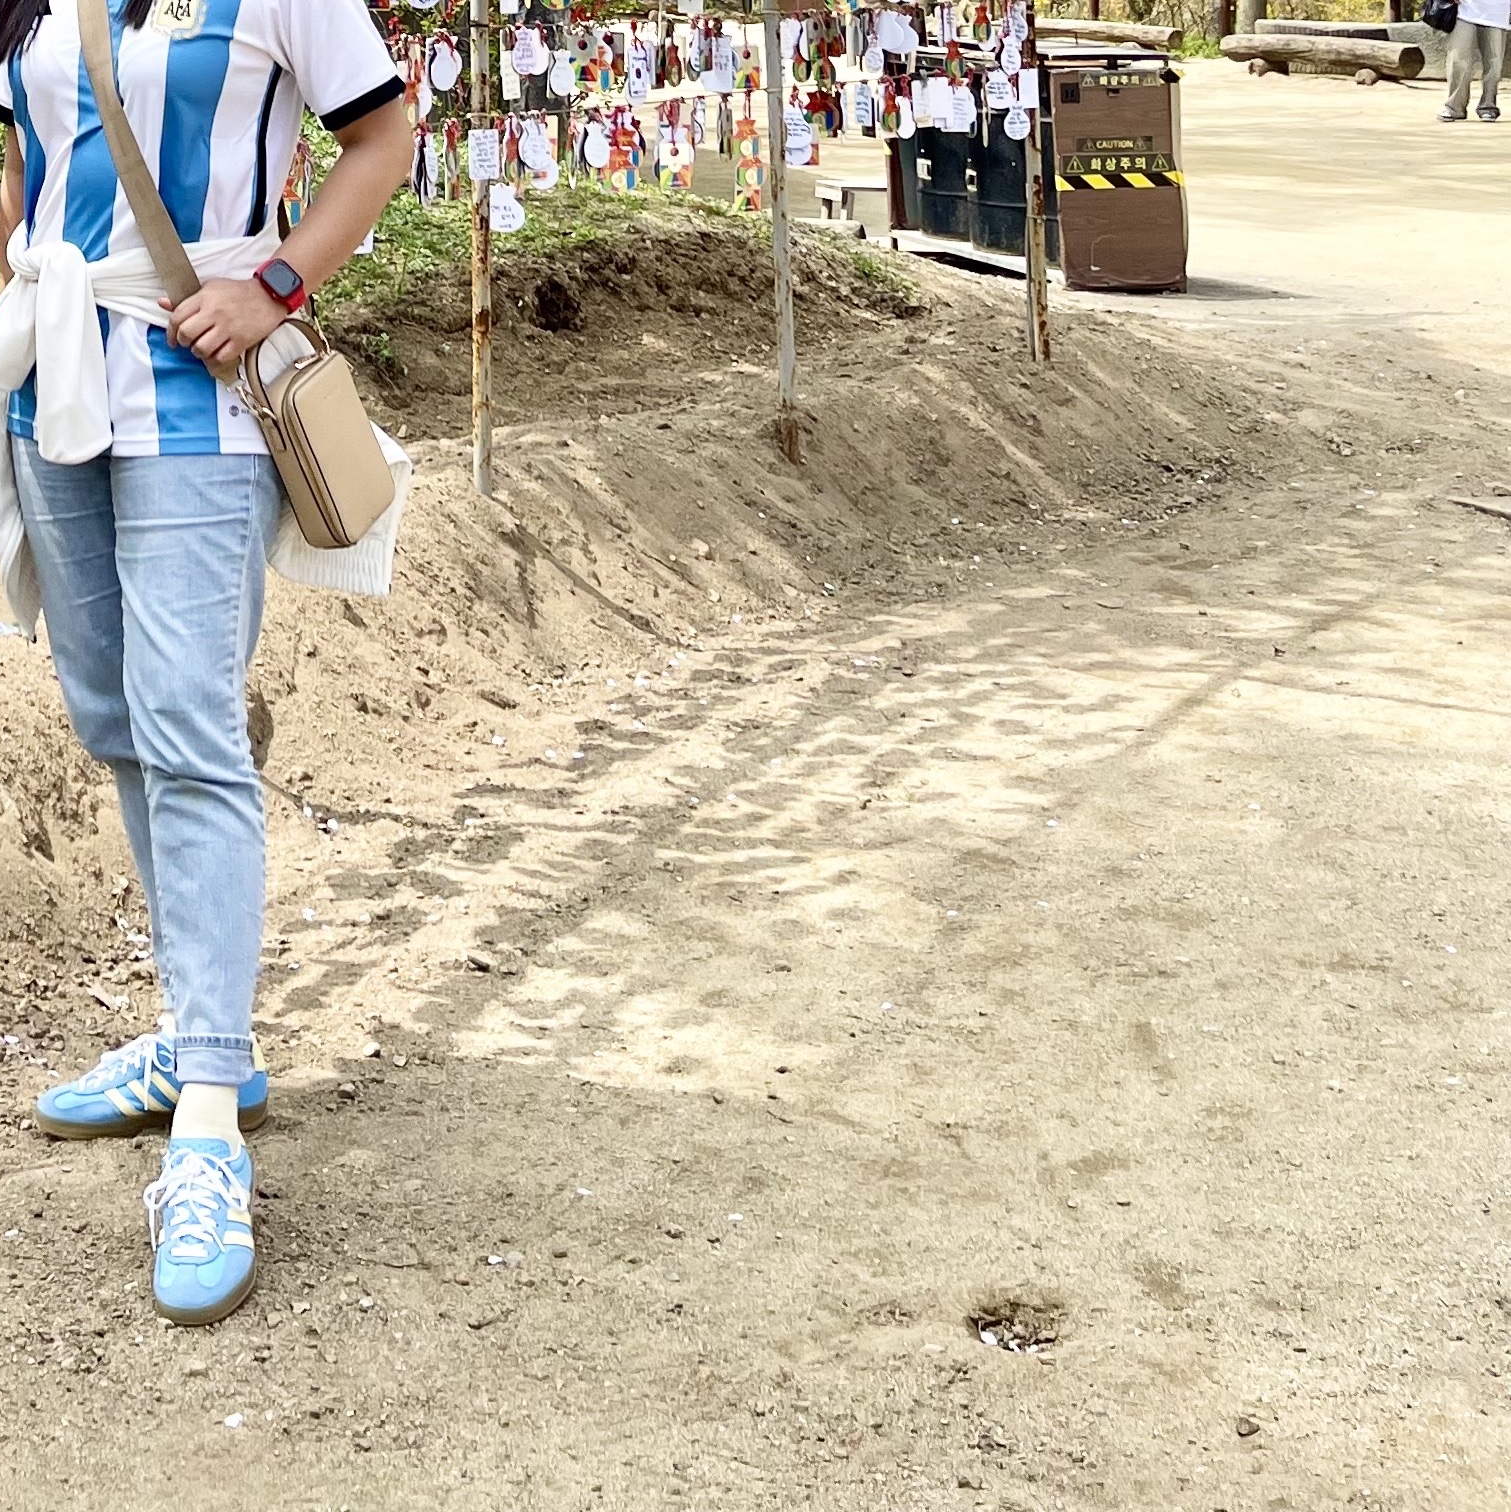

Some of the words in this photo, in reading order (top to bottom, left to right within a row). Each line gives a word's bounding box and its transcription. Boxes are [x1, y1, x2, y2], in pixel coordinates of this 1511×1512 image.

[1099, 75, 1139, 86] 화상주의
[1096, 140, 1134, 149] CAUTION
[1090, 157, 1146, 170] 화상주의
